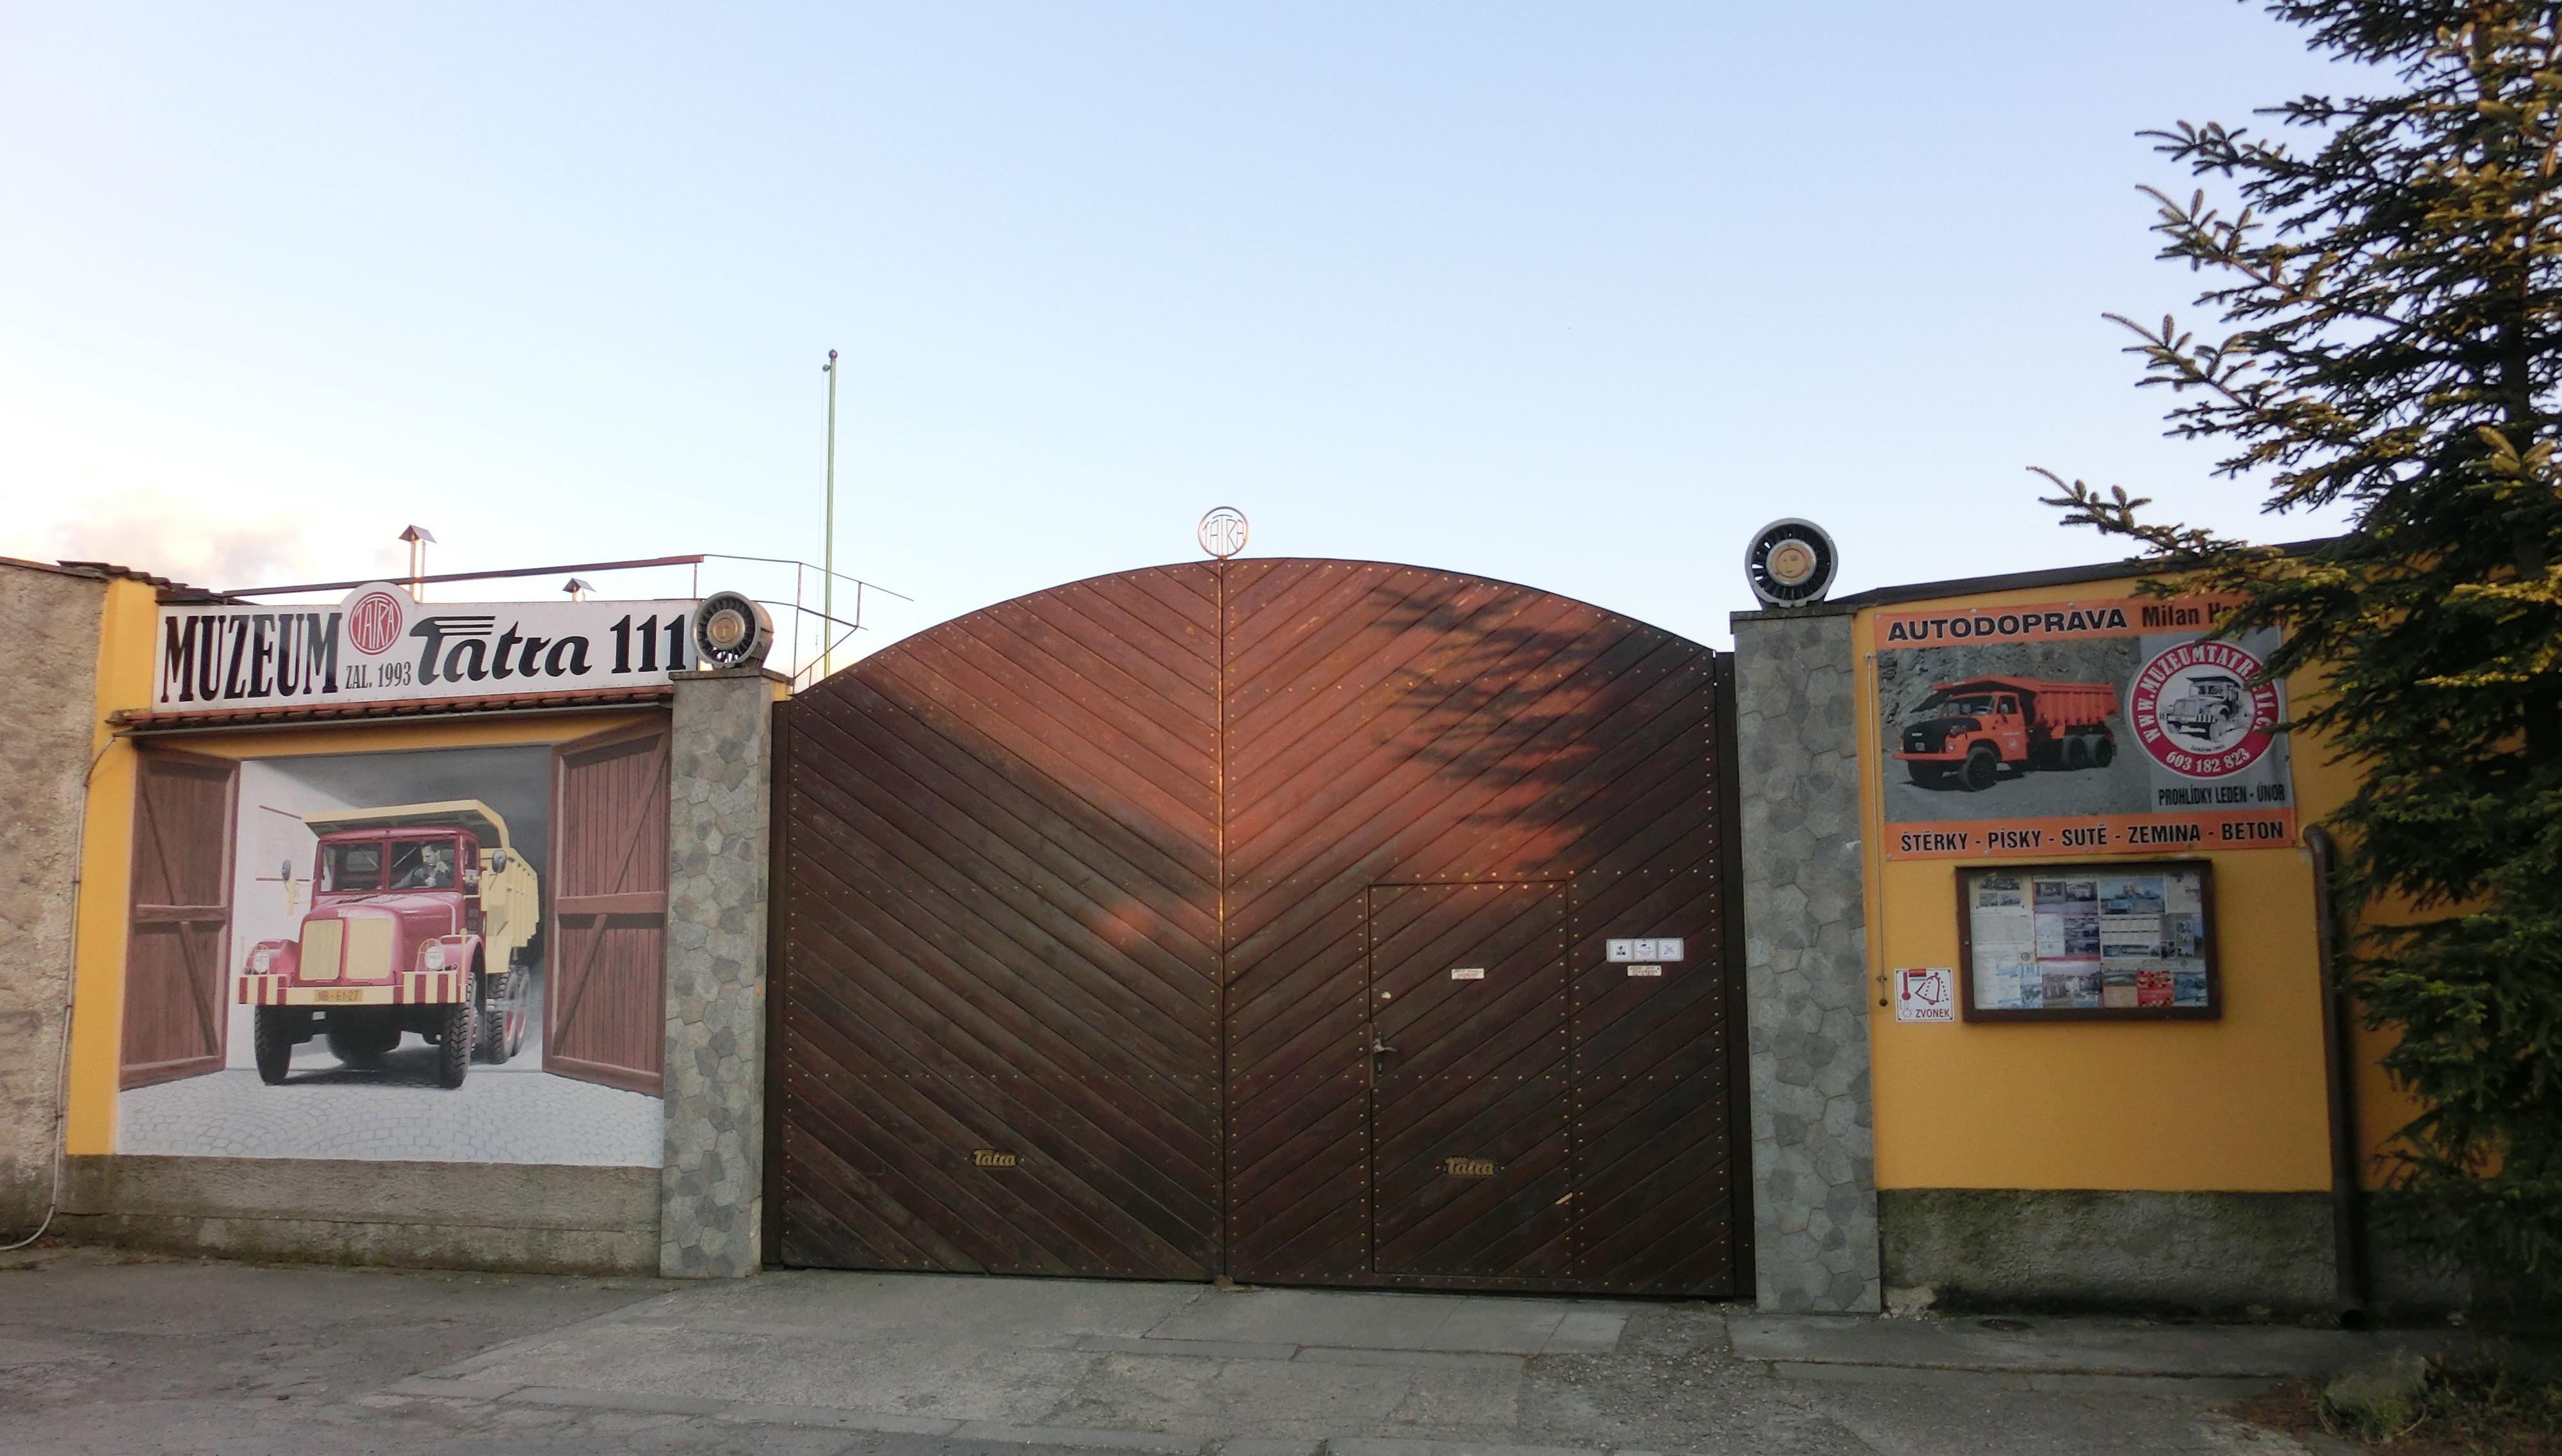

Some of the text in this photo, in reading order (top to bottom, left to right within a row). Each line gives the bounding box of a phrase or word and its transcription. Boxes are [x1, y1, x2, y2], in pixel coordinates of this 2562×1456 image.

[355, 598, 396, 650] TATRA
[1888, 608, 2127, 641] AUTODOPRAVA
[2142, 606, 2199, 627] Milan
[161, 613, 343, 703] MUZEUM
[409, 614, 686, 686] Tatra 111
[345, 661, 412, 689] ZAL. 1993
[2166, 748, 2251, 773] 603 182 823
[2158, 784, 2212, 805] PROHLÍDKY
[2215, 786, 2246, 804] LEDEN
[2257, 782, 2285, 801] ÚNOR
[1901, 830, 1968, 851] ŠTĚRKY
[1988, 827, 2041, 848] PÍSKY
[2062, 824, 2107, 846] SUTĚ
[2127, 824, 2201, 844] ZEMINA
[2221, 821, 2283, 841] BETON
[1916, 1008, 1950, 1018] ZVONEK
[973, 1149, 1016, 1166] Tatra
